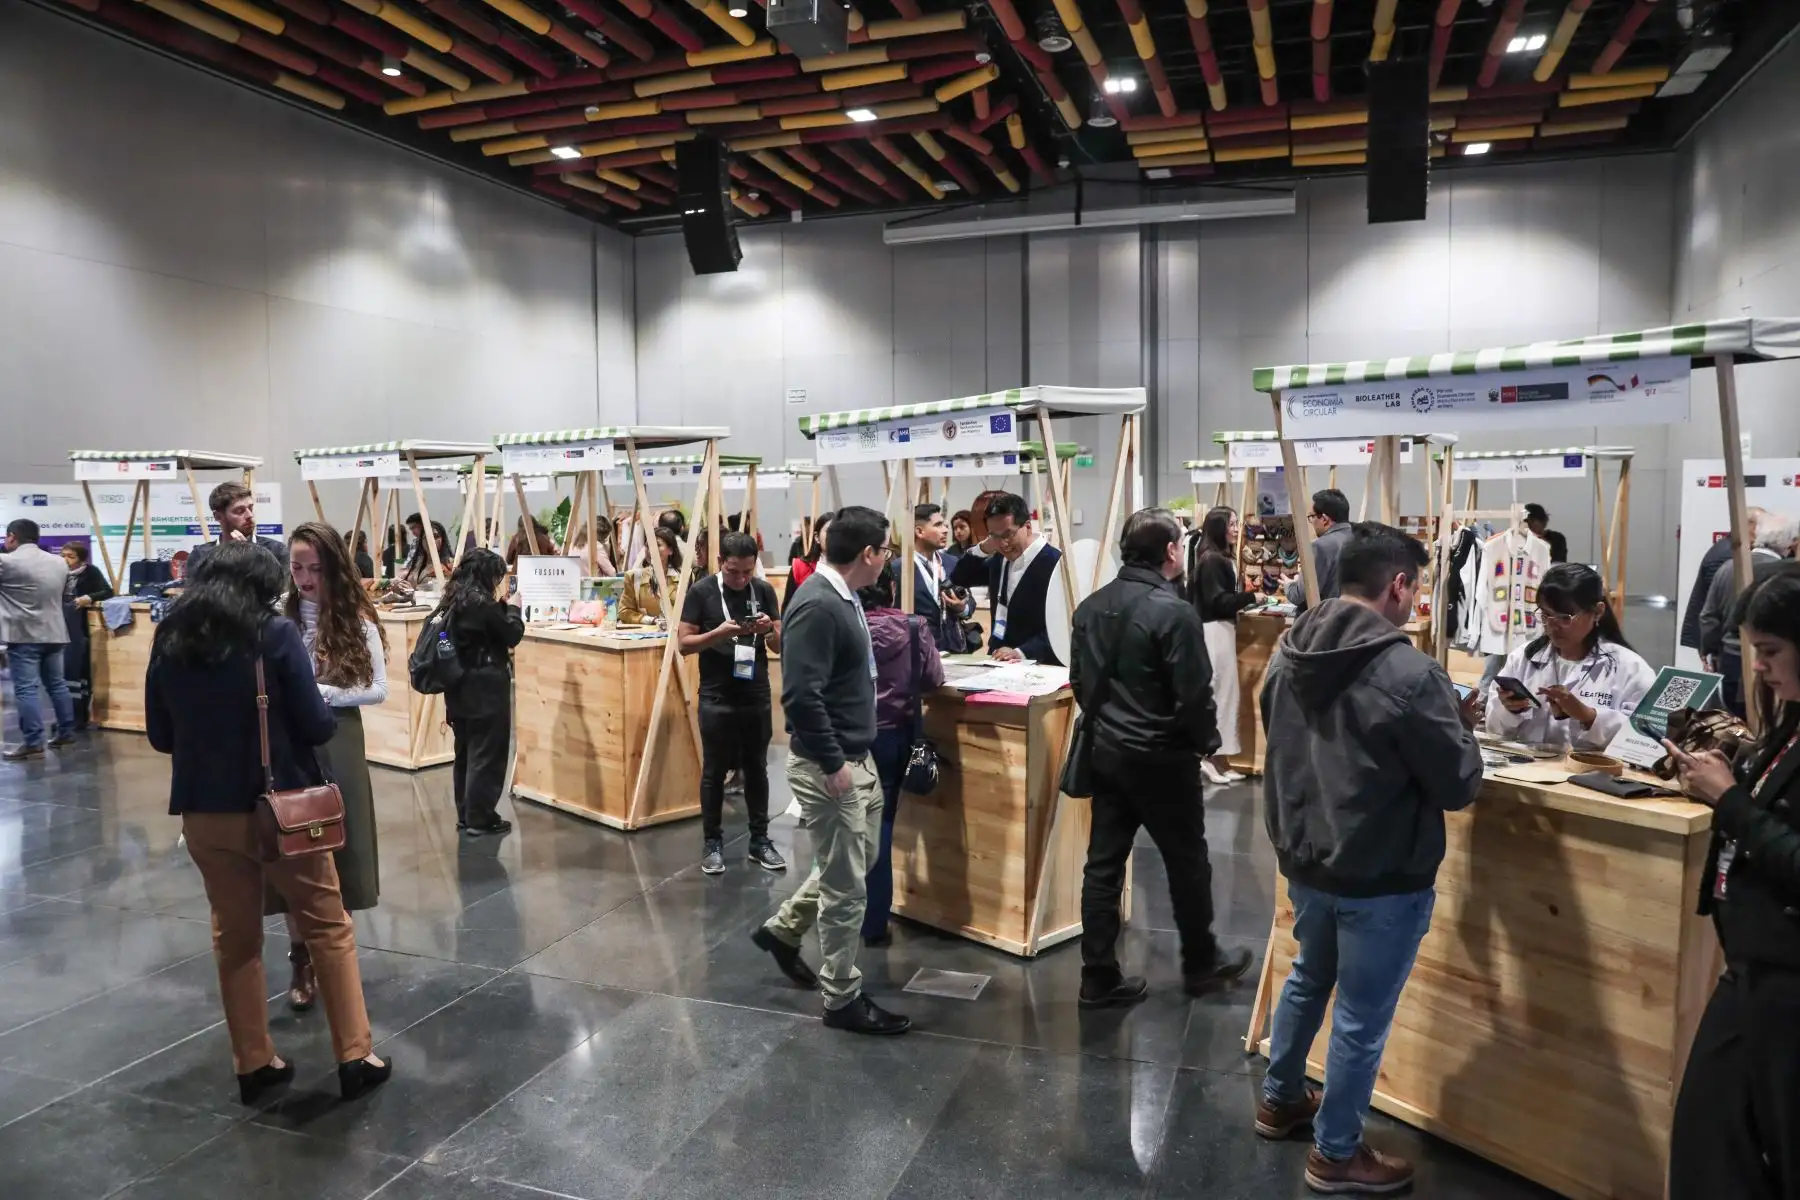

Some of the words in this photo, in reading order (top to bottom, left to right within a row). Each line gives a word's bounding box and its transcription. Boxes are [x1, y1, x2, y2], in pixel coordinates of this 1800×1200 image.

[1355, 392, 1401, 402] BIOLEATHER
[1303, 408, 1337, 417] CIRCULAR
[534, 568, 565, 576] FUSSION
